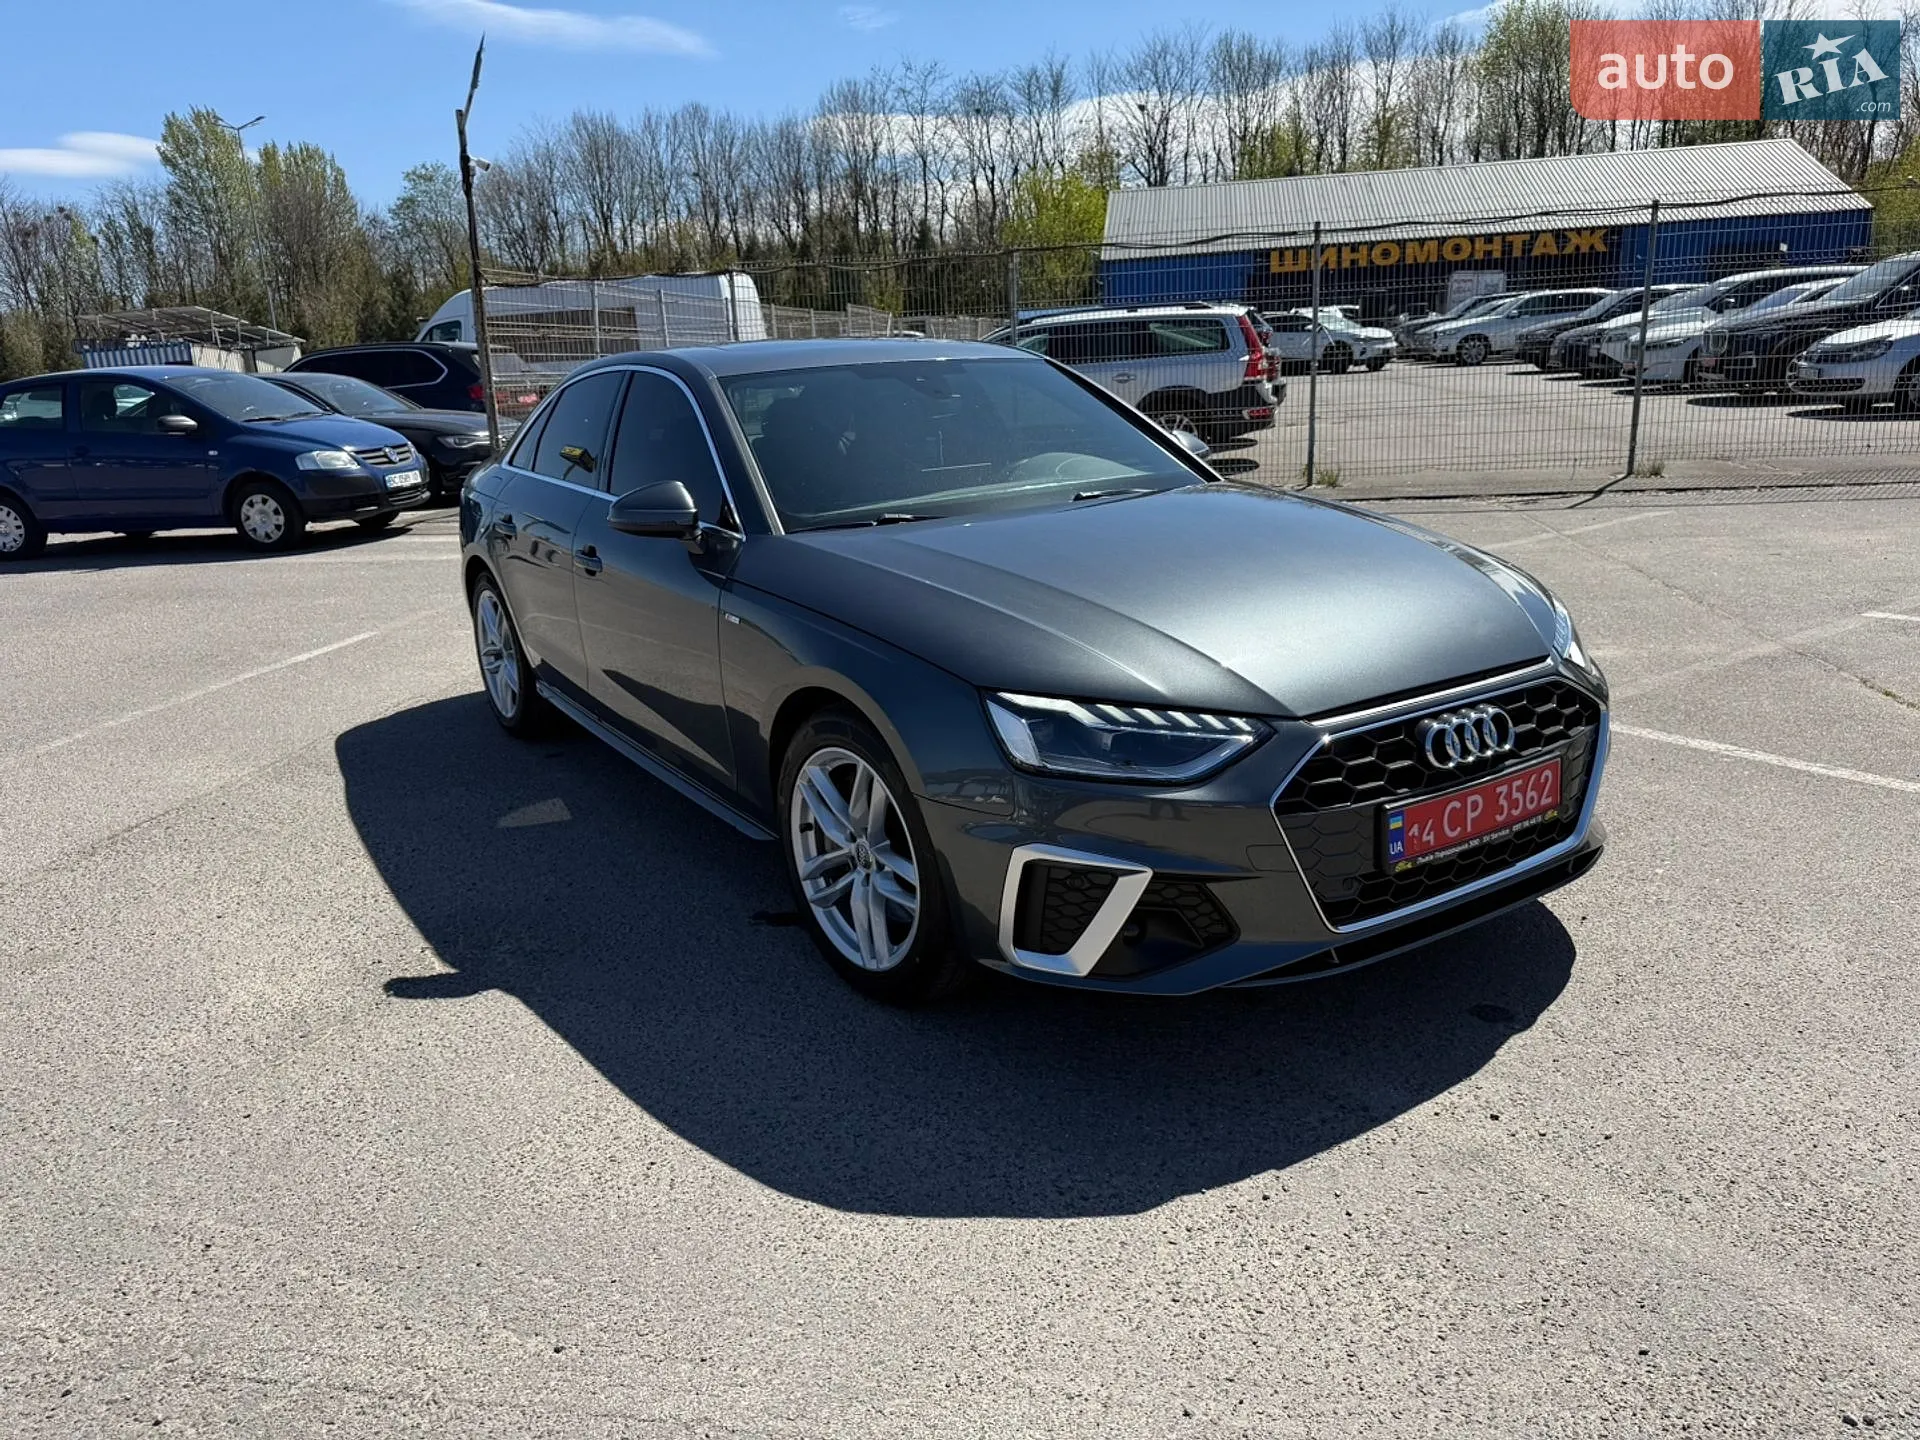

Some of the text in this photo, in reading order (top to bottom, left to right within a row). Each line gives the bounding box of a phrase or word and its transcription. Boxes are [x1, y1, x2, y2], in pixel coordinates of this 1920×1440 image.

[1270, 228, 1609, 274] ШИНОМОНТАЖ
[1443, 794, 1484, 838] CP
[1495, 769, 1553, 823] 3562
[1389, 841, 1404, 855] UA
